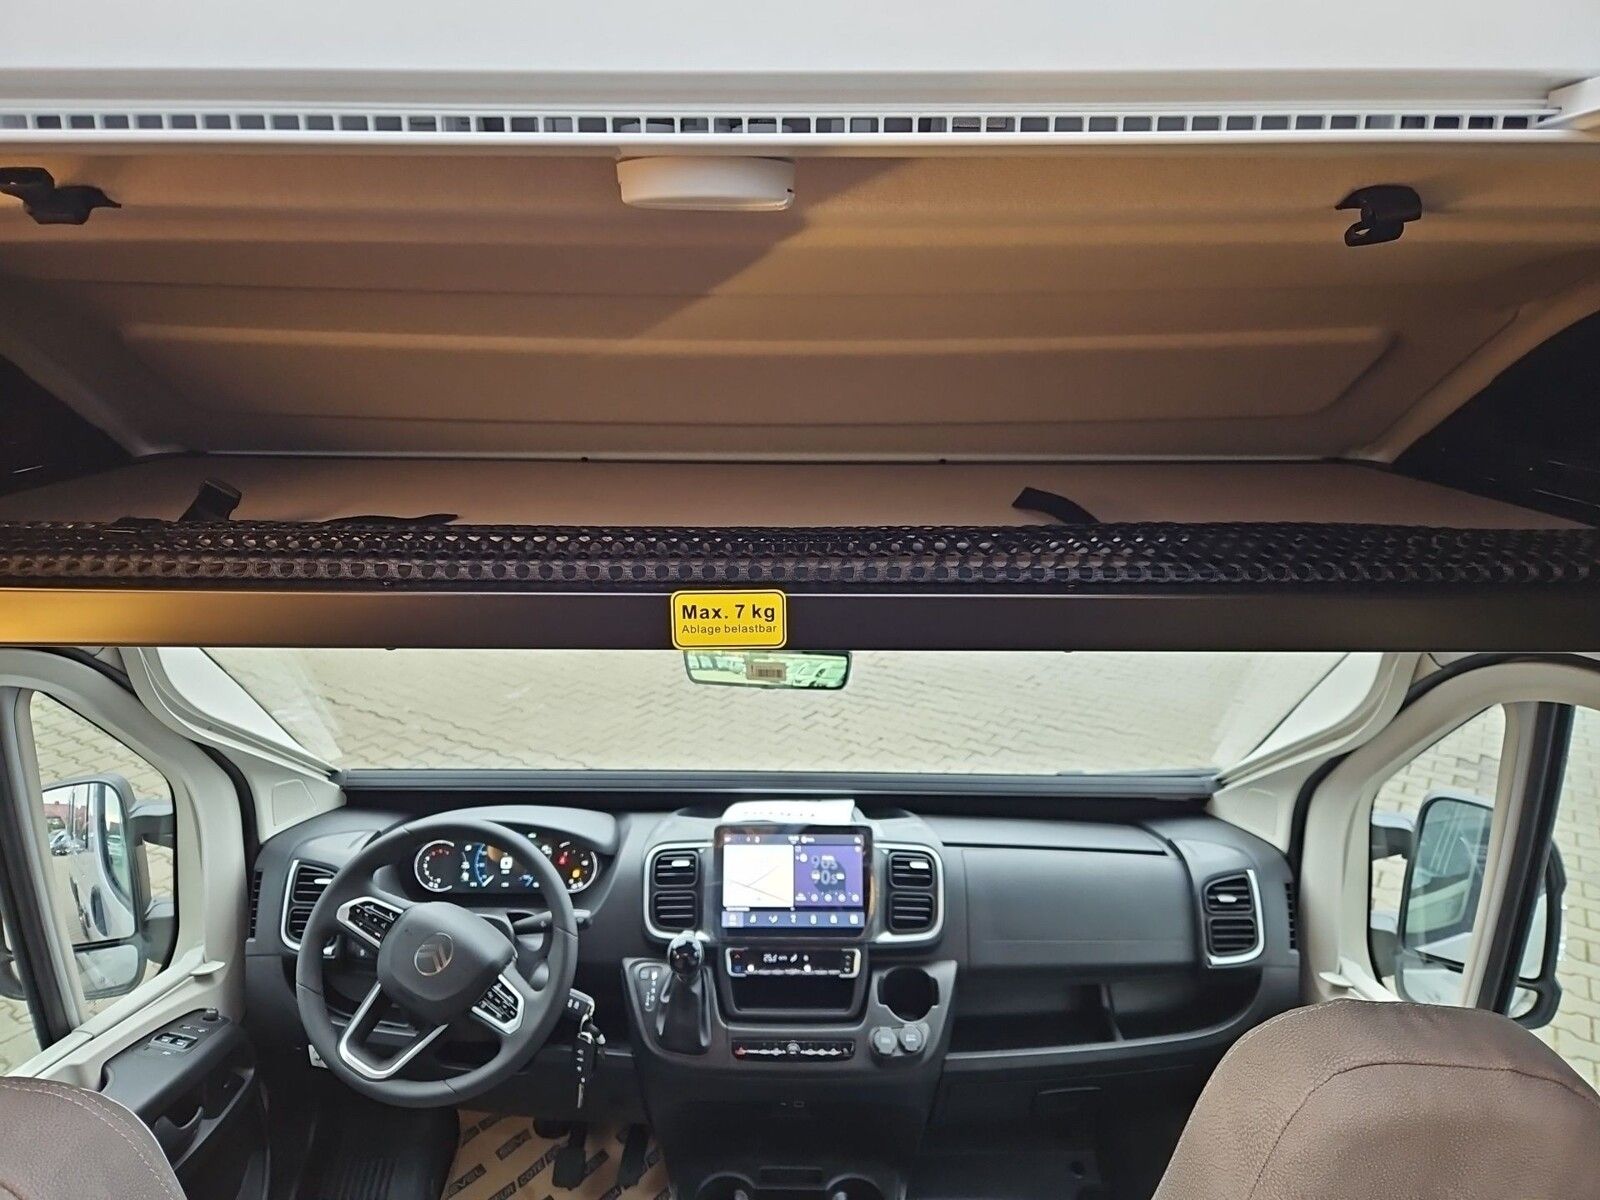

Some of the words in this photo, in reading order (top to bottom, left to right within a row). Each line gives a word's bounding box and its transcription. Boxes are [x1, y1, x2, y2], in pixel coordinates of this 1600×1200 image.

[682, 604, 729, 619] Max.
[735, 604, 745, 619] 7
[752, 603, 775, 622] kg
[682, 624, 721, 636] Ablage
[724, 623, 777, 634] belastbar
